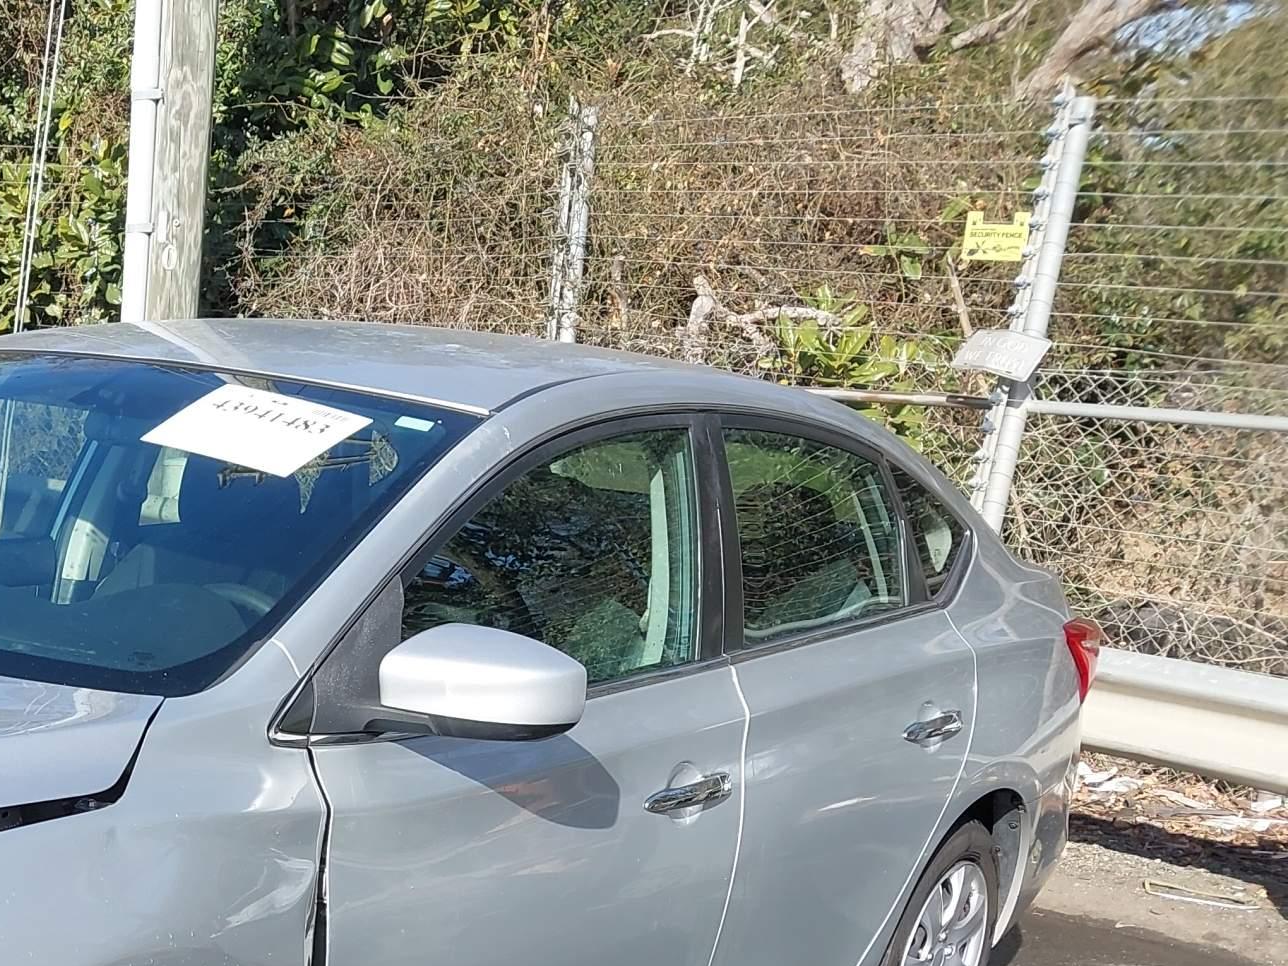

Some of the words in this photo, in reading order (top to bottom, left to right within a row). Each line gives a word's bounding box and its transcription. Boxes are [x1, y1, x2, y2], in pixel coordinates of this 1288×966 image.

[969, 231, 1001, 239] SECURITY
[996, 338, 1028, 353] GOD
[985, 352, 1026, 370] TRUST
[212, 400, 331, 434] 43941483
